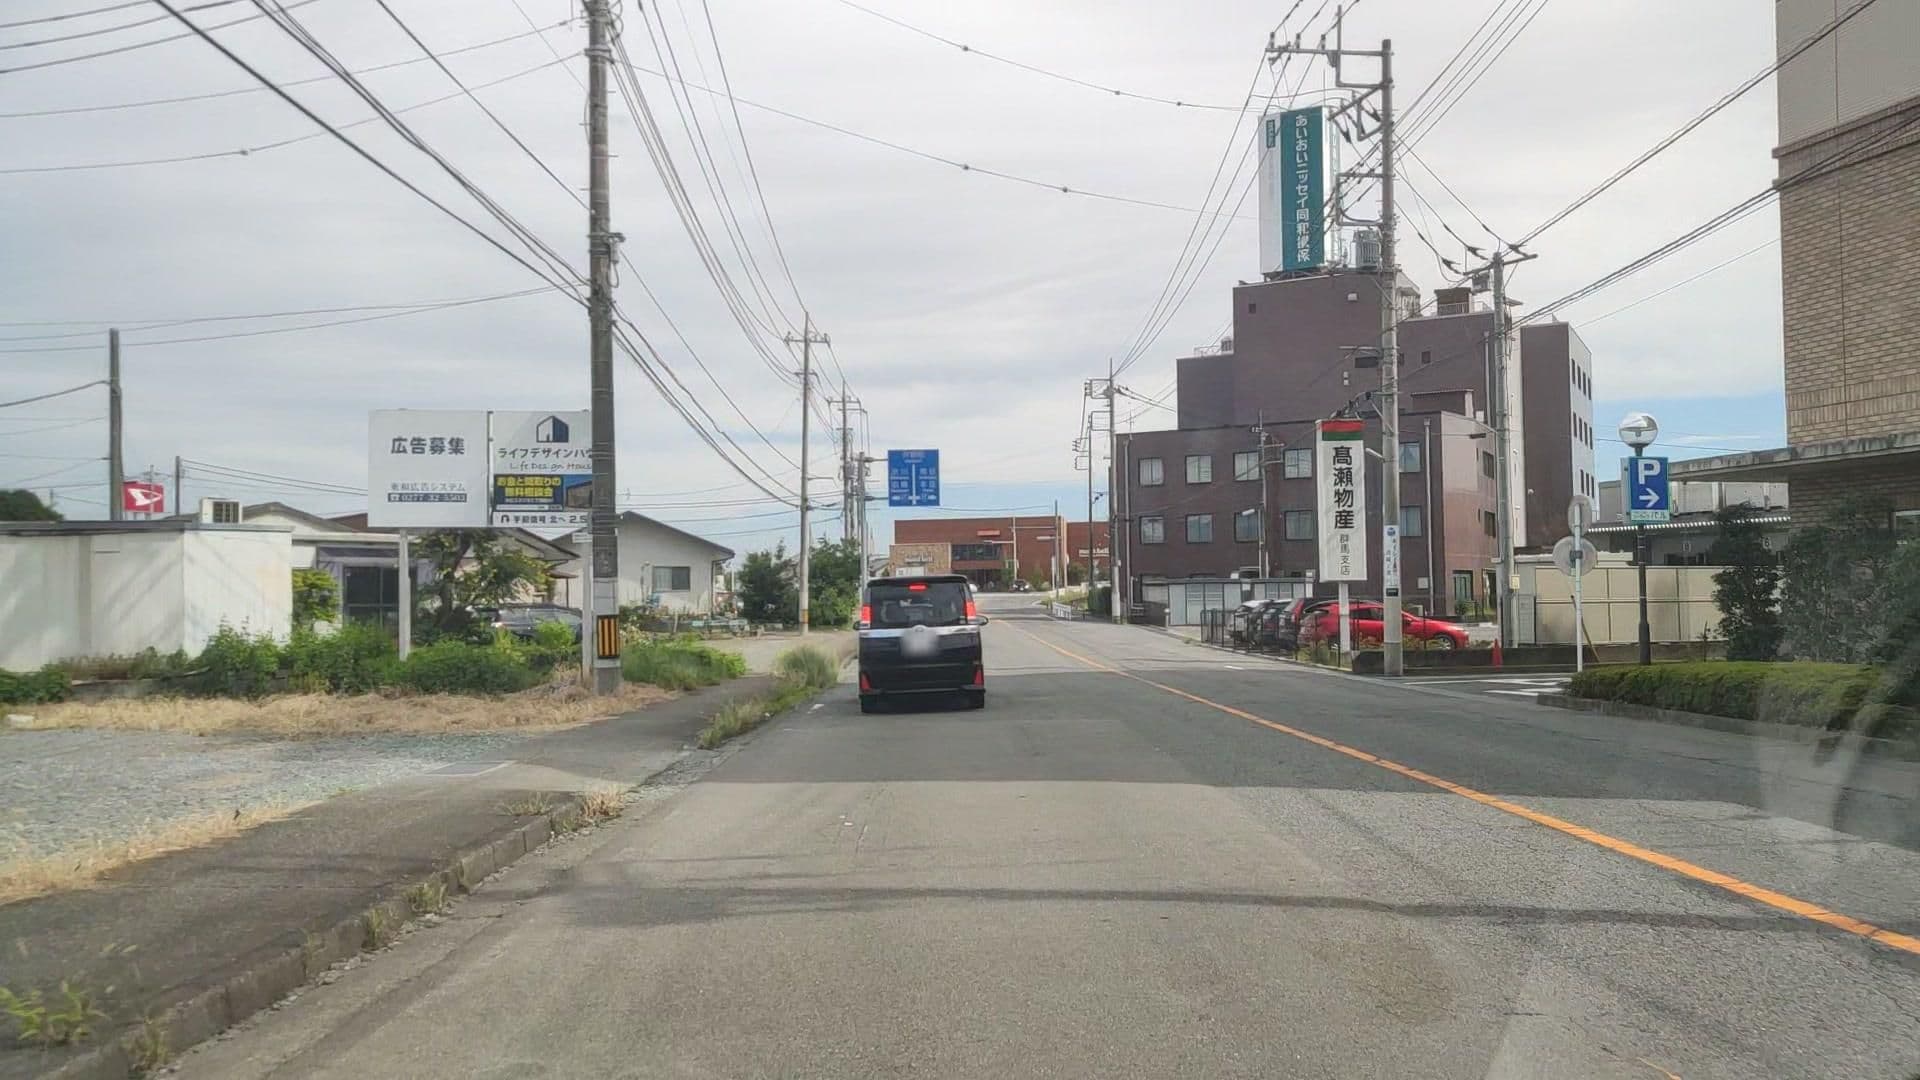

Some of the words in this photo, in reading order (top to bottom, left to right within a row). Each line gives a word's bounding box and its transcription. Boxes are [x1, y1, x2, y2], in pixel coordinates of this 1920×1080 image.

[390, 436, 466, 456] 広告募集
[496, 447, 592, 459] ライフデザインハウ
[1637, 459, 1661, 485] P
